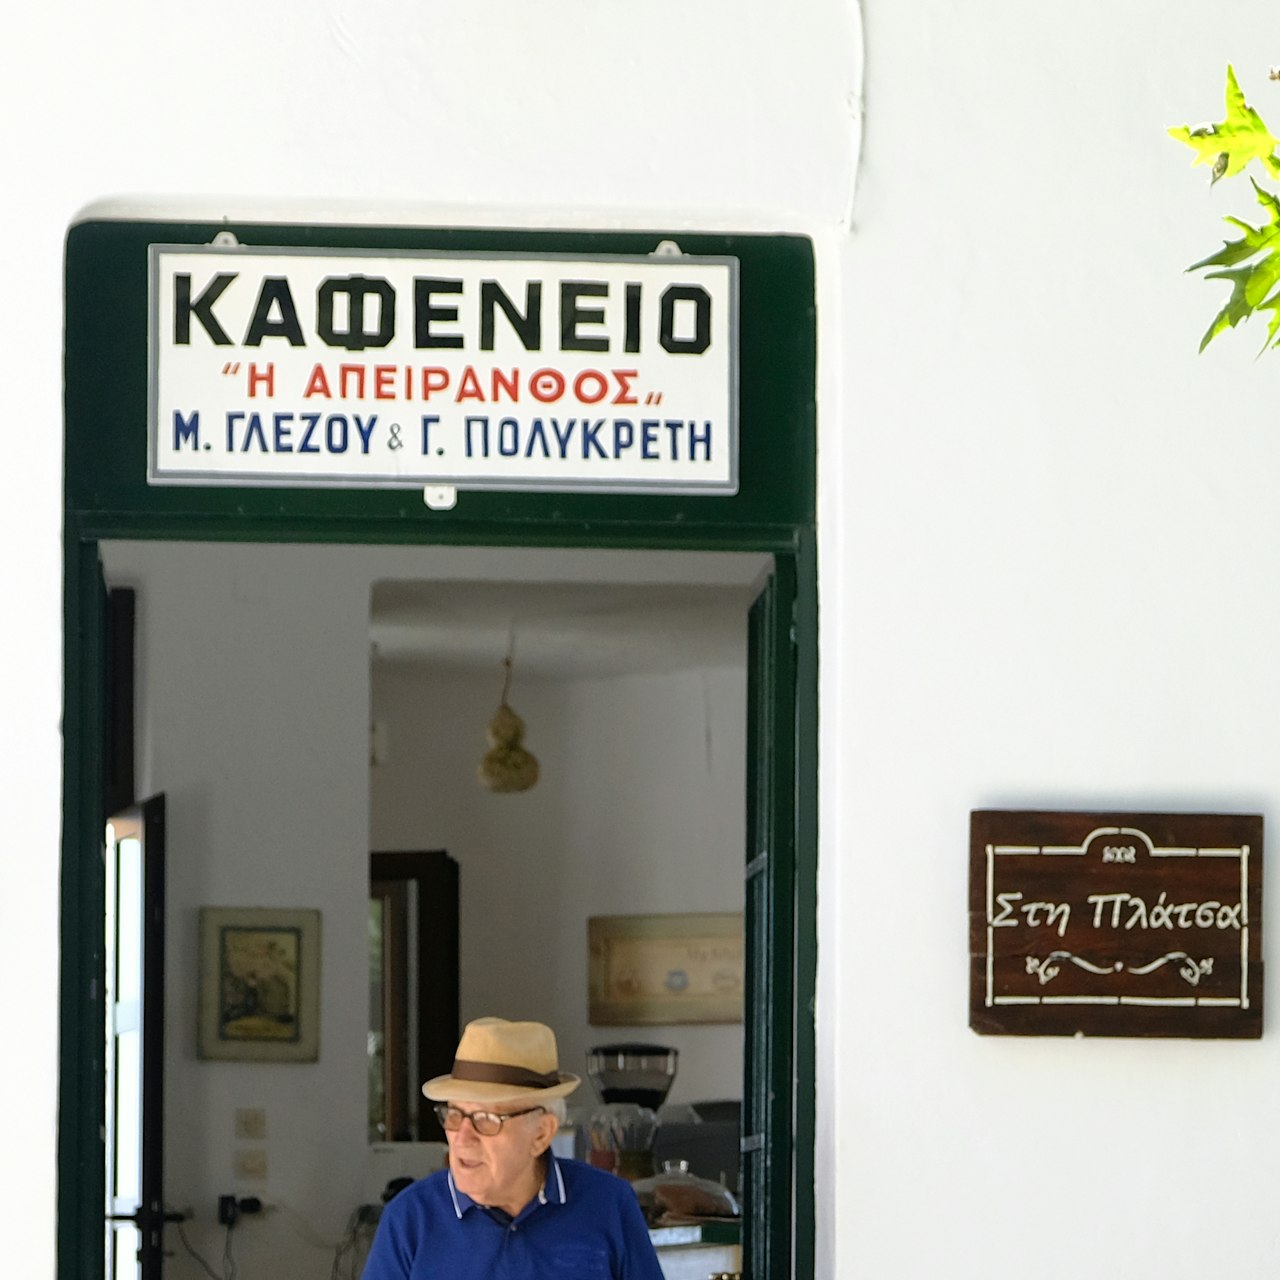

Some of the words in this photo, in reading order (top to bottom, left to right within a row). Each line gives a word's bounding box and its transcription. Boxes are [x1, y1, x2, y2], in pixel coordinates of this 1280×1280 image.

[171, 271, 712, 355] ΚΑΦΕΝΕΙΟ
[172, 410, 212, 453] Μ.
[225, 411, 378, 455] ΓΛΕΖΟΥ
[387, 422, 404, 451] &
[420, 415, 445, 458] Γ.
[464, 416, 712, 462] ΠΟΛΥΚΡΕΤΗ
[992, 891, 1070, 937] Στη
[1087, 891, 1242, 931] Πλάτσα
